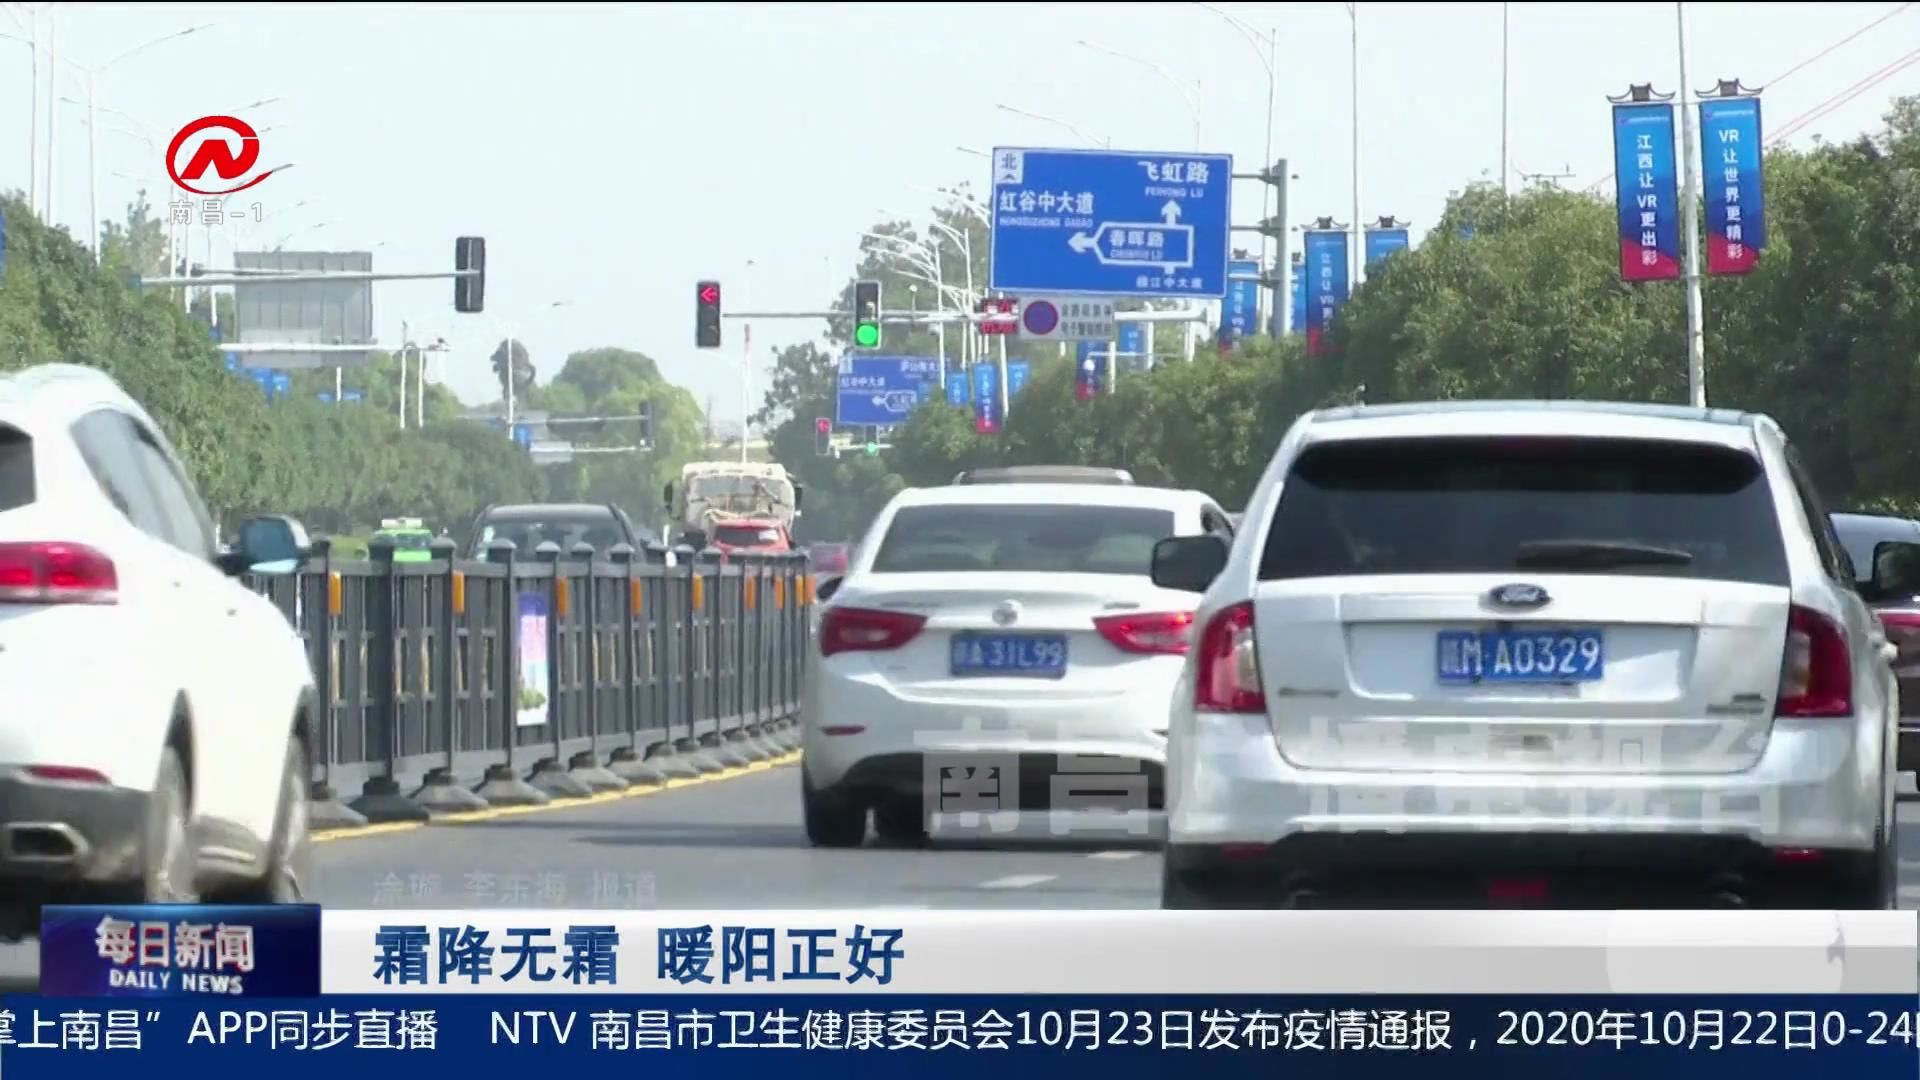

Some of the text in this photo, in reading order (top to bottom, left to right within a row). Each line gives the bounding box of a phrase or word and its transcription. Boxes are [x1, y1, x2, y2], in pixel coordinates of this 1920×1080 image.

[1002, 153, 1017, 170] 北
[1137, 160, 1209, 184] 飞虹路
[1000, 190, 1094, 215] 红谷中大道
[1637, 134, 1657, 266] 江西让VR更出彩
[1718, 129, 1742, 260] VR让世界更精彩
[1109, 230, 1164, 248] 春晖路
